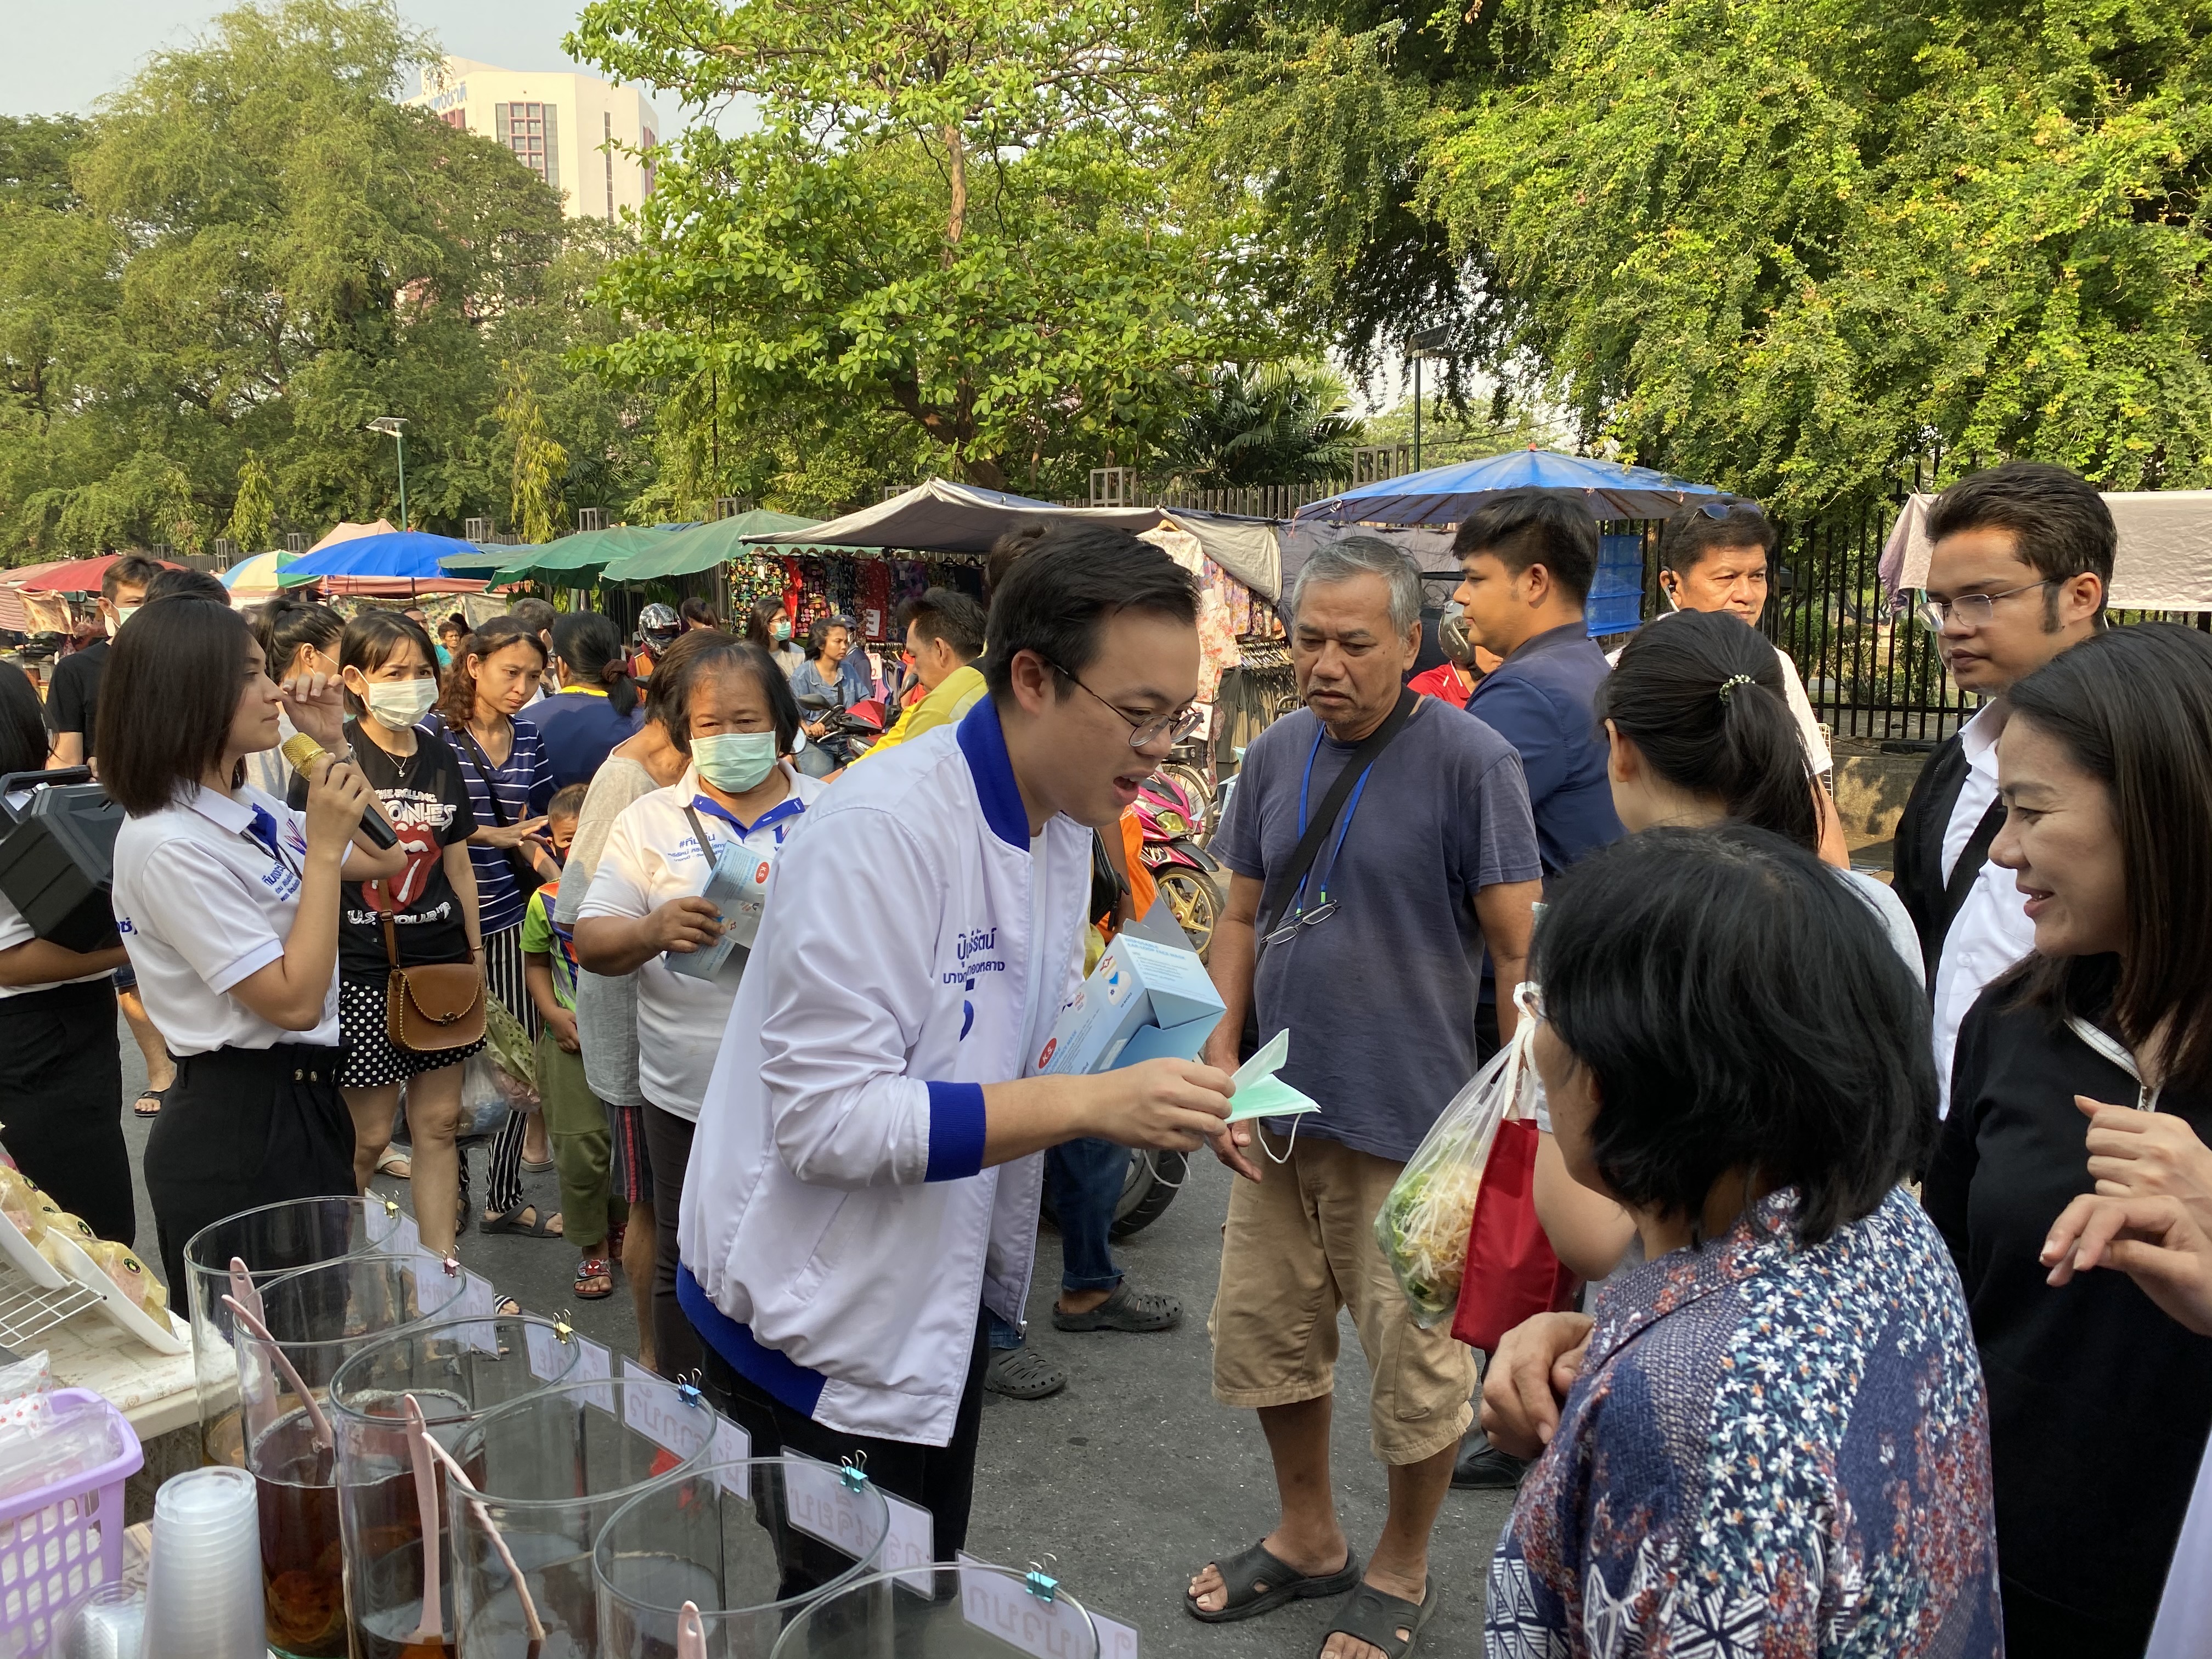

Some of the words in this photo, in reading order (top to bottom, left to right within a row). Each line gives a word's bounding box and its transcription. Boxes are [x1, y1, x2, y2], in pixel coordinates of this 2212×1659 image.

[393, 788, 437, 803] ROLLING
[383, 799, 457, 832] ONES
[757, 866, 768, 878] K.S.
[347, 910, 378, 925] U.S.
[1042, 1046, 1054, 1063] K.S.
